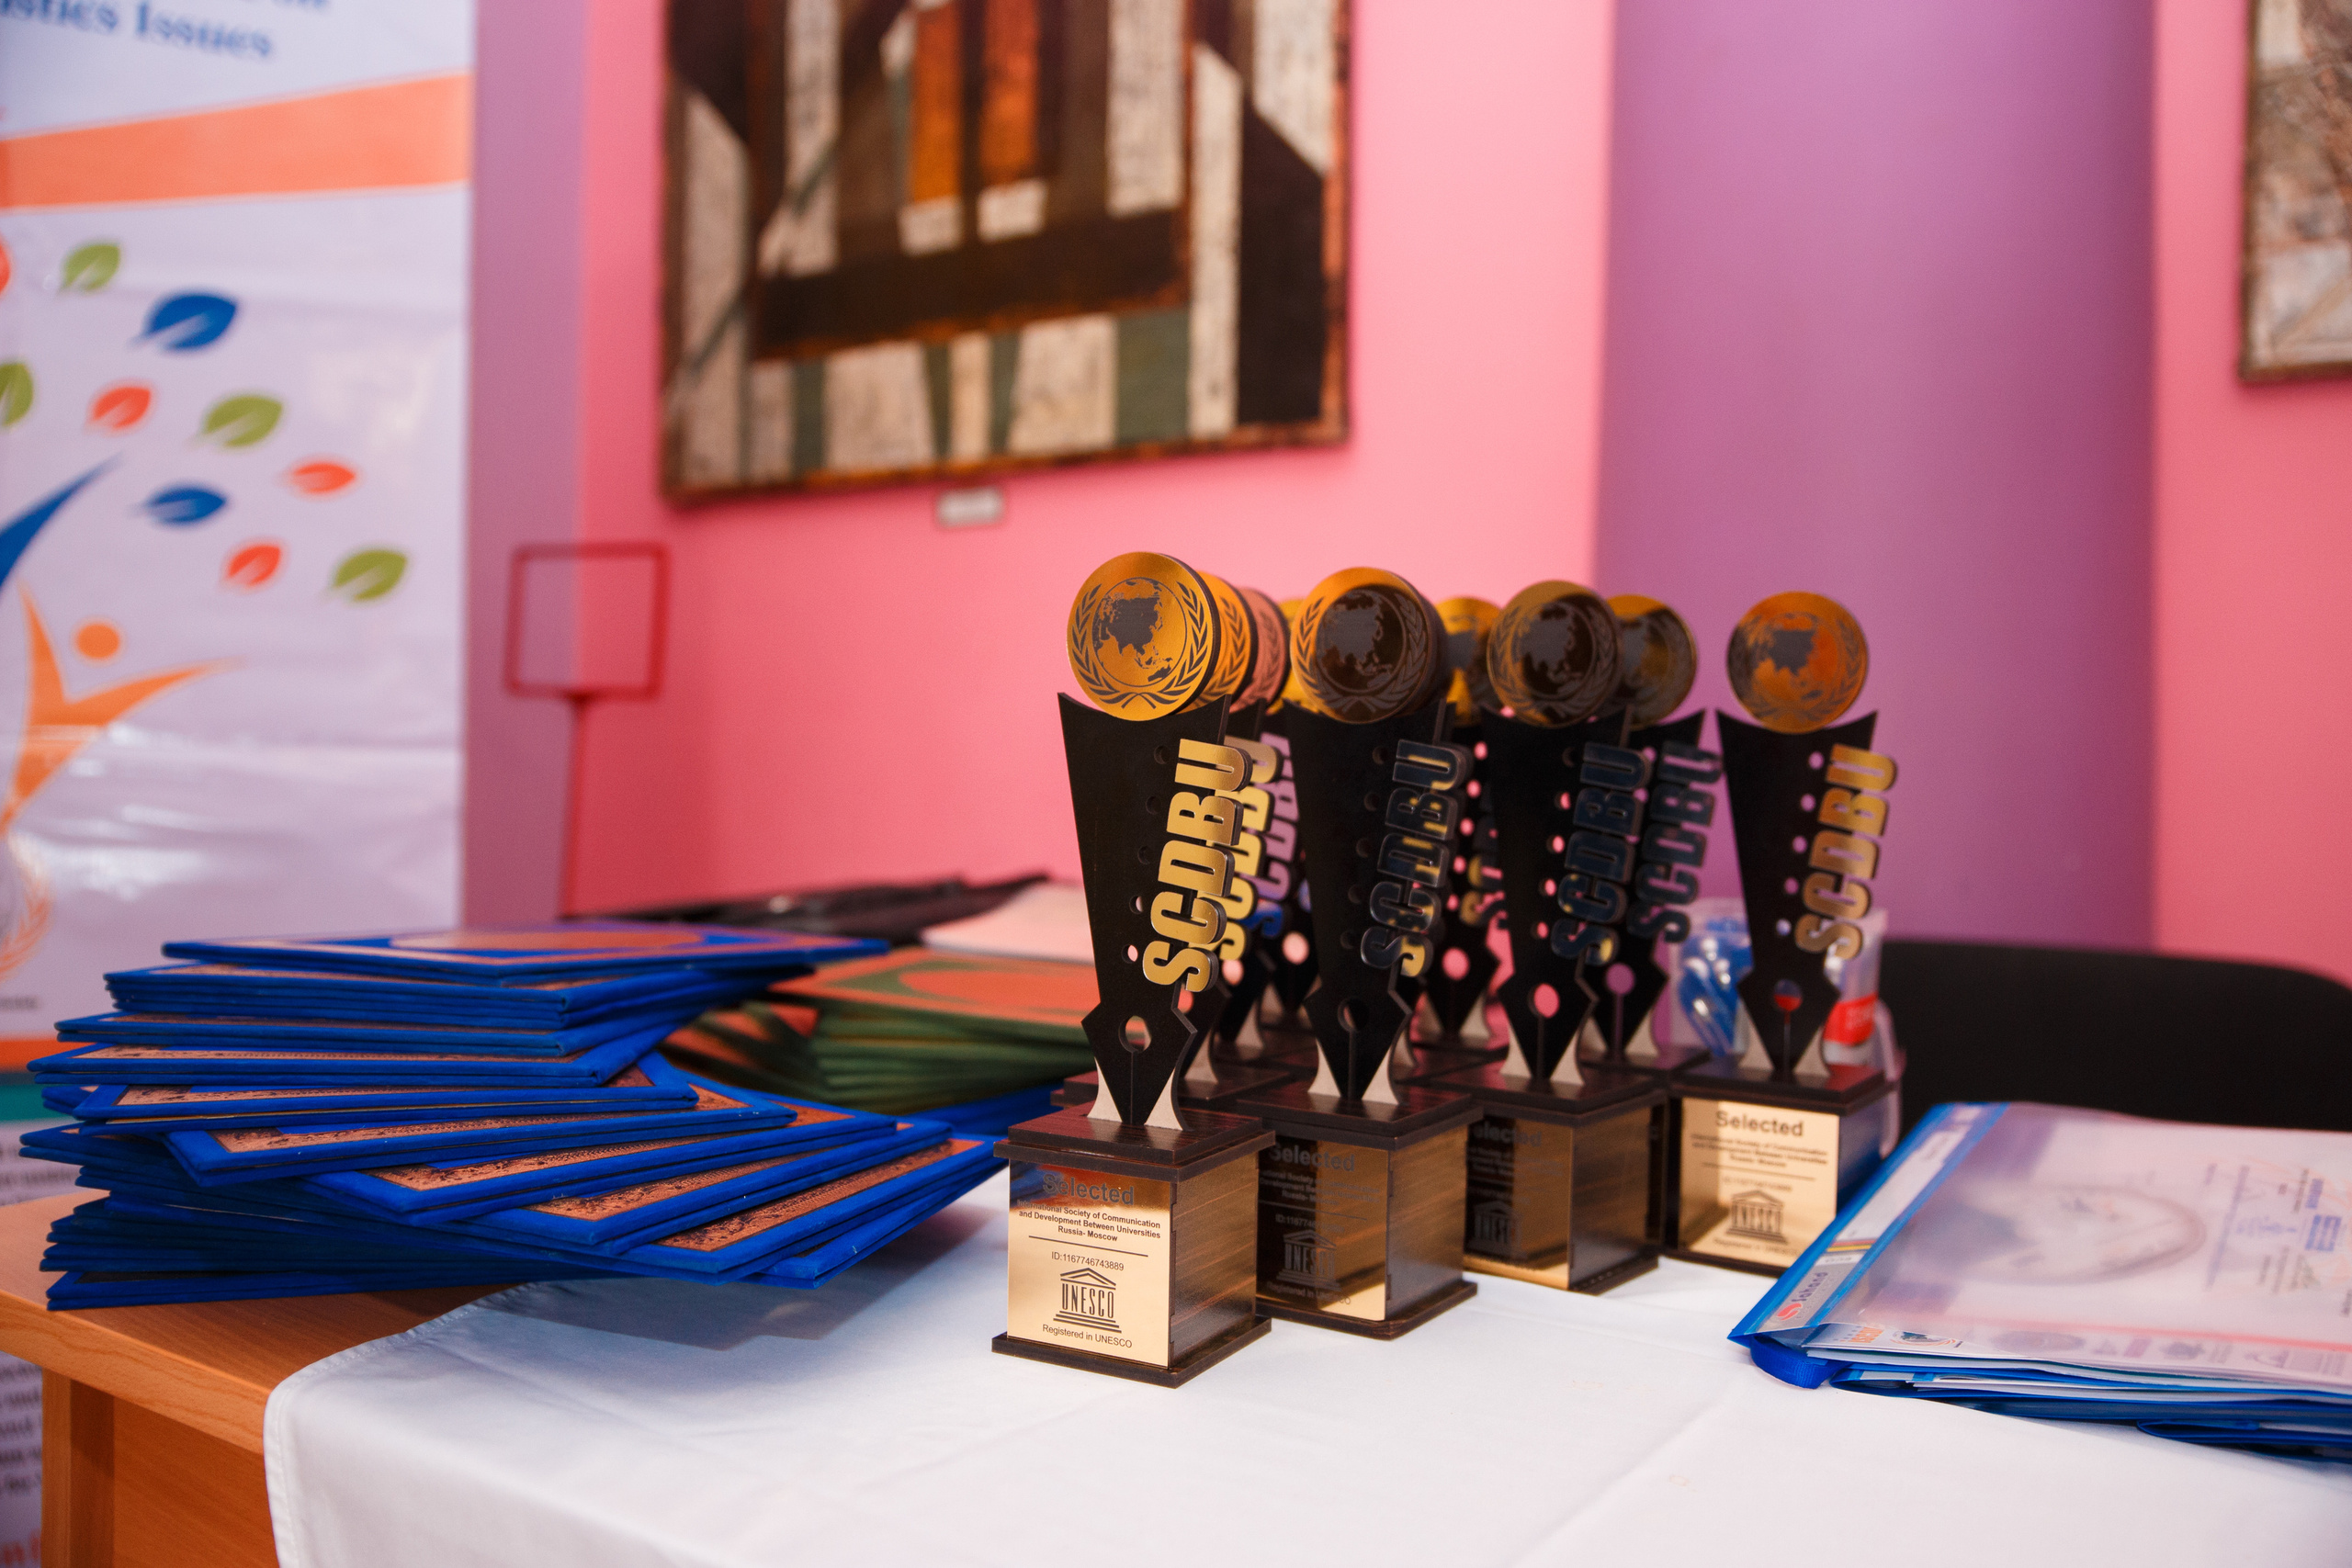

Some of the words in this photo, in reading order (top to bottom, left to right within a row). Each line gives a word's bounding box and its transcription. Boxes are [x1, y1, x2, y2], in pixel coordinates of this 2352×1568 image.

[135, 4, 275, 57] Issues
[1142, 738, 1251, 993] SCDBU
[1551, 741, 1651, 966] SCDBU
[1794, 743, 1897, 961] SCDBU
[1715, 1110, 1804, 1137] Selected
[1270, 1142, 1355, 1172] Selected
[1043, 1174, 1135, 1205] Selected
[1017, 1199, 1062, 1213] International
[1064, 1207, 1091, 1220] Society
[1102, 1213, 1161, 1229] Communication
[1019, 1210, 1033, 1219] and
[1035, 1212, 1081, 1226] Development
[1083, 1220, 1115, 1232] Between
[1116, 1224, 1161, 1239] Universities
[1058, 1225, 1086, 1236] Russia-
[1087, 1231, 1118, 1242] Moscow
[1051, 1251, 1125, 1271] ID:1167746743889
[1061, 1282, 1114, 1319] UNESCO
[1042, 1324, 1084, 1339] Registered
[1086, 1331, 1093, 1341] in
[1094, 1333, 1133, 1348] UNESCO
